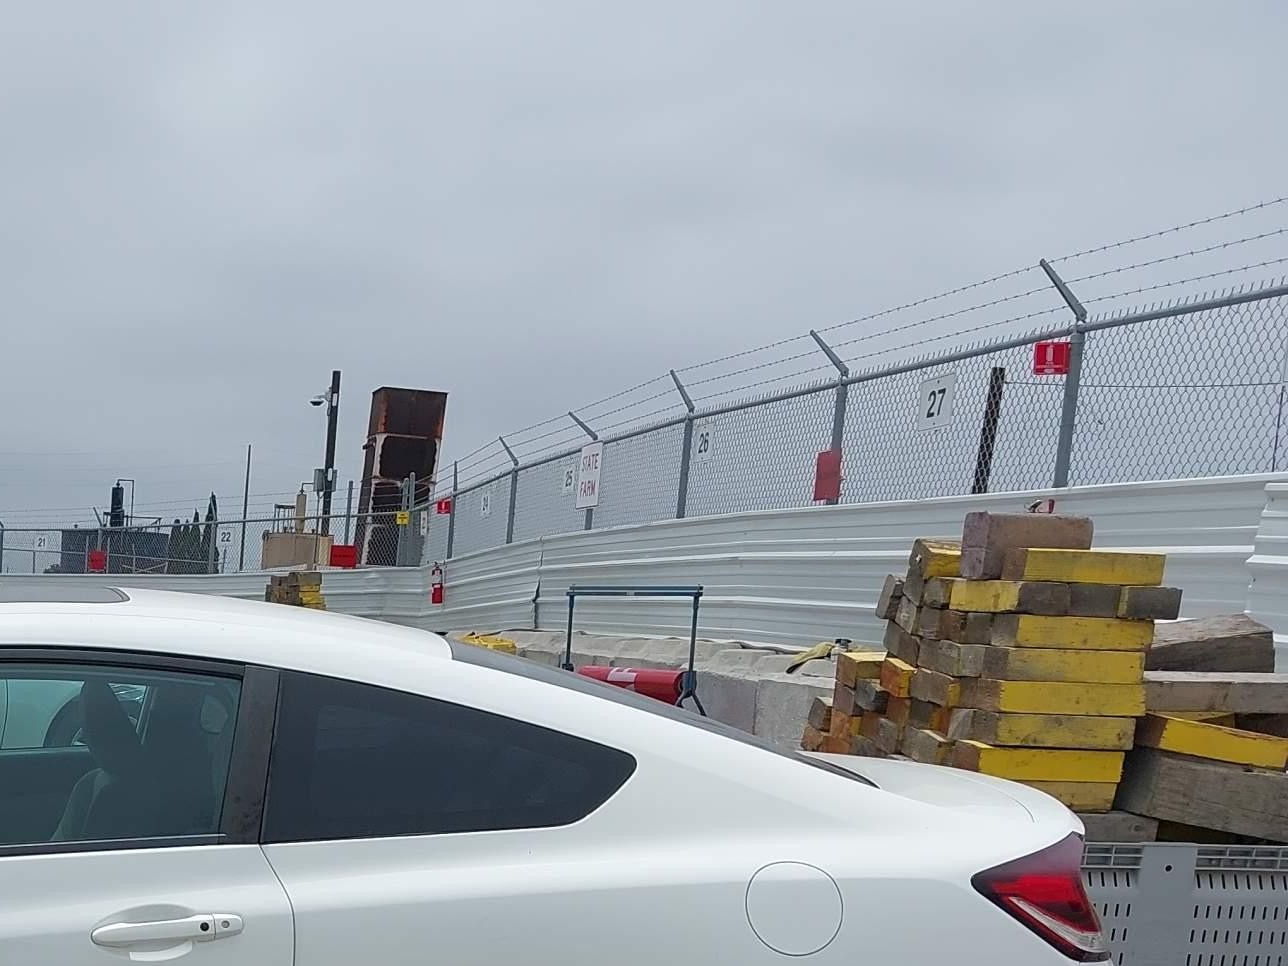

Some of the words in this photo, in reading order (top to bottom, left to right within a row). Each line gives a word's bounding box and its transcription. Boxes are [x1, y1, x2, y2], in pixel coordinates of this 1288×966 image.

[926, 387, 947, 418] 27
[698, 432, 710, 453] 26
[582, 453, 599, 472] STATE
[565, 470, 573, 487] 25
[579, 480, 596, 497] FARM
[37, 537, 46, 547] 21
[220, 532, 231, 543] 22
